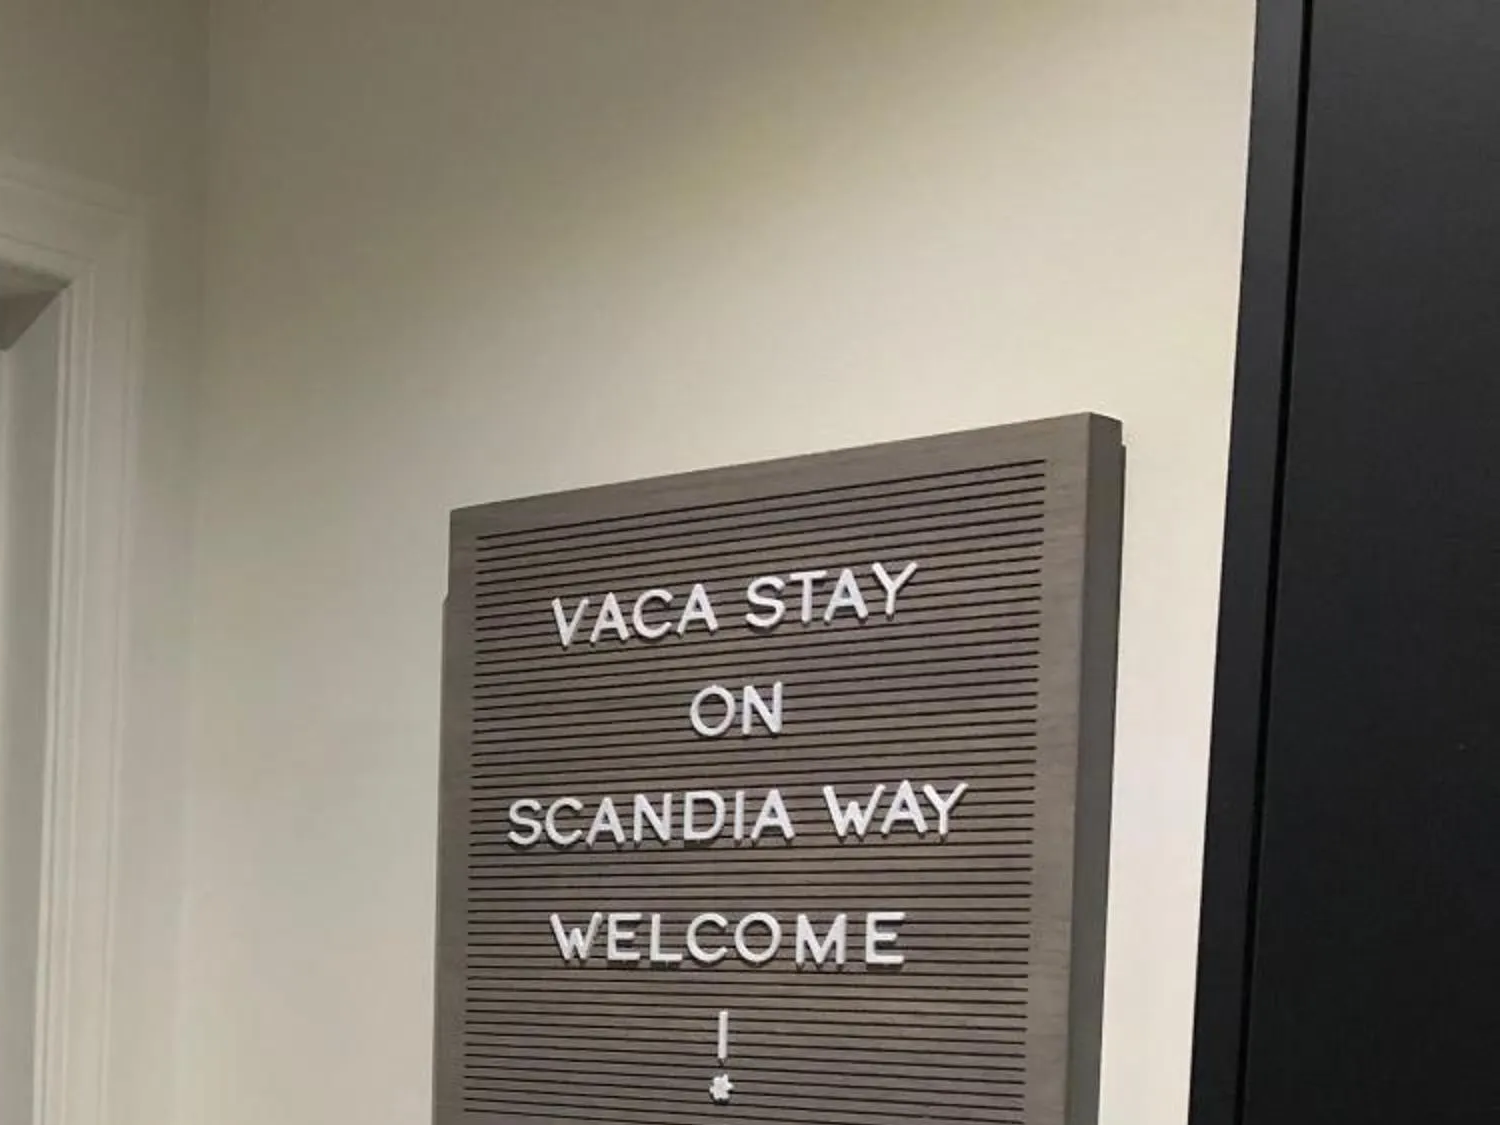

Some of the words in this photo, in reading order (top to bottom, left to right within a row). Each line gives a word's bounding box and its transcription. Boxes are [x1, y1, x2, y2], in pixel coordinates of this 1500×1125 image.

[551, 583, 719, 647] VACA
[745, 561, 918, 628] STAY
[689, 681, 783, 736] ON
[507, 789, 795, 846] SCANDIA
[822, 780, 969, 838] WAY
[550, 911, 906, 965] WELCOME
